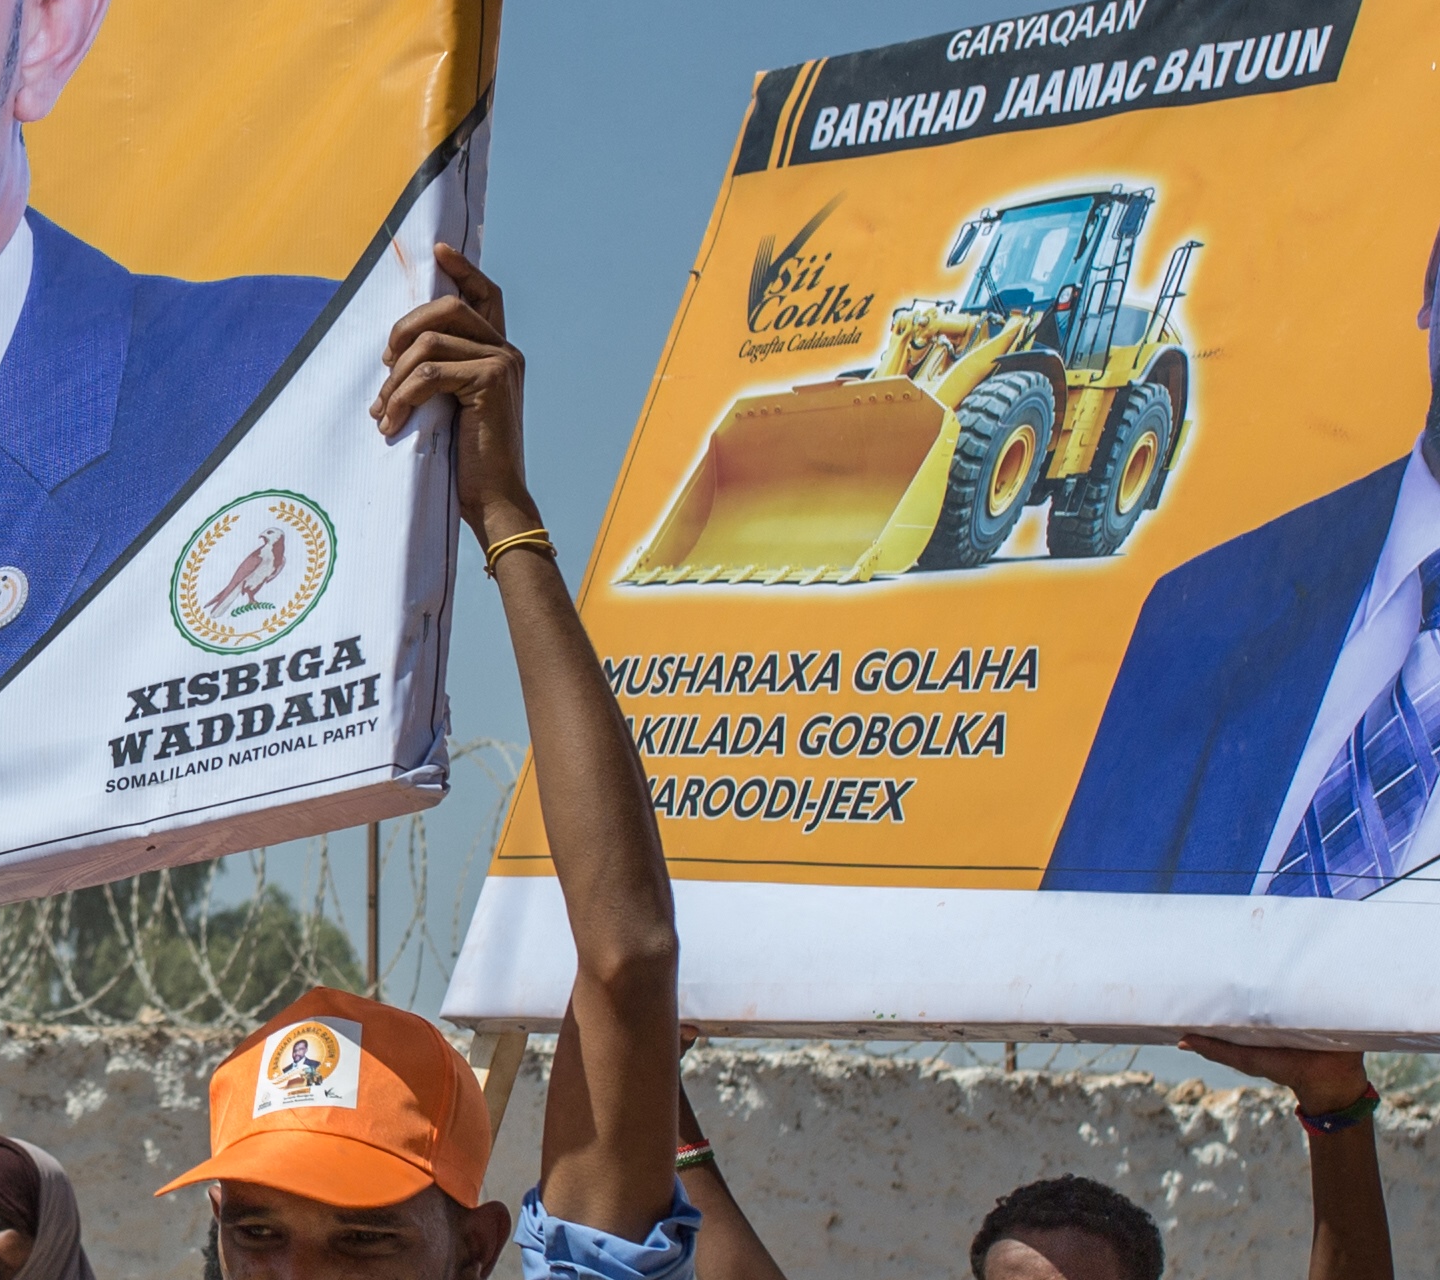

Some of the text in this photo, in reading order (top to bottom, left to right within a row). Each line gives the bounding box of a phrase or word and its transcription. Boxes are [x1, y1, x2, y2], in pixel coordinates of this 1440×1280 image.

[809, 25, 1333, 151] BARKHAD JAAMAC BATUUN
[748, 283, 875, 334] Codka
[738, 333, 785, 363] Cagafta
[125, 635, 366, 723] XISBIGA
[601, 645, 1039, 697] MUSHARAXA GOLAHA
[108, 673, 381, 769] WADDANI
[624, 712, 1007, 758] KIILADA GOBOLKA
[105, 717, 379, 793] SOMALILAND NATIONAL PARTY
[647, 776, 916, 833] AROODI-JEEX
